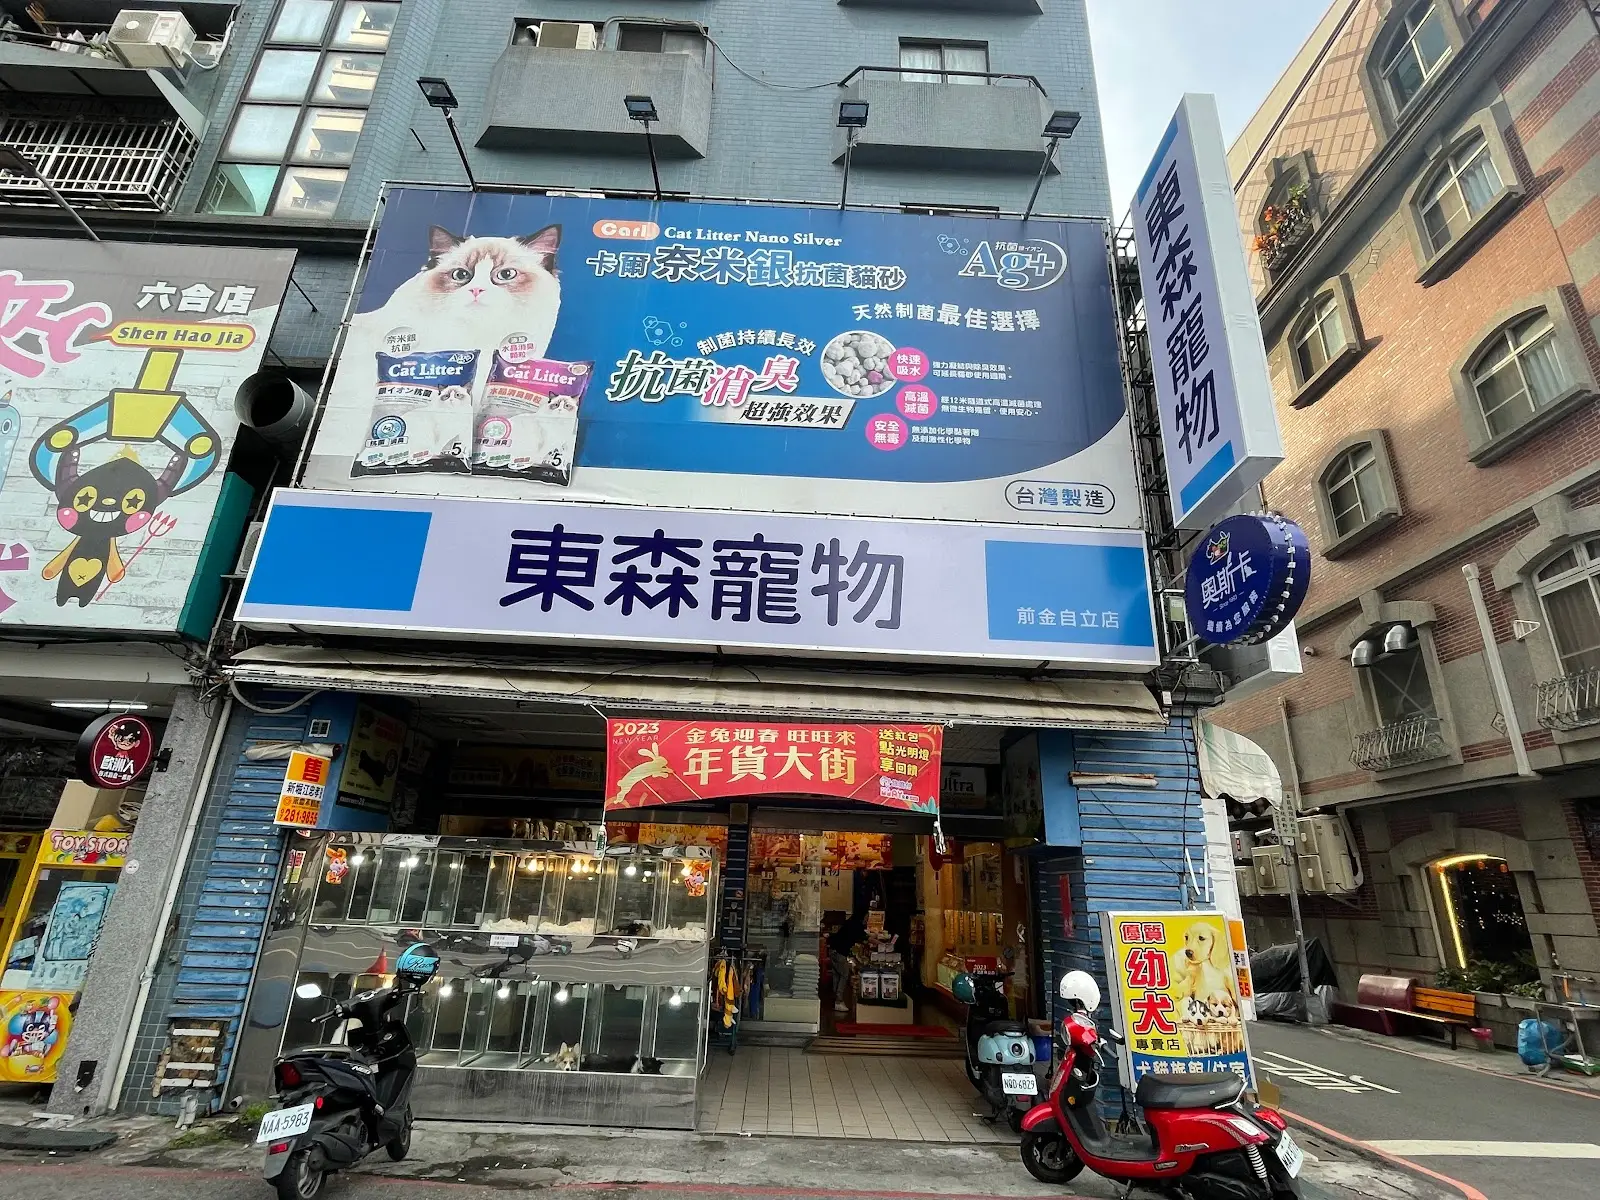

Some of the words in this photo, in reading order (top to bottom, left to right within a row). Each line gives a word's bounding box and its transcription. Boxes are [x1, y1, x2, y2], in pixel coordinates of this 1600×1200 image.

[600, 223, 647, 238] Carl
[664, 226, 692, 241] Cat
[696, 228, 741, 243] Litter
[745, 231, 789, 244] Nano
[793, 232, 842, 248] Silver
[586, 245, 907, 290] 卡爾奈米銀抗菌貓砂
[958, 241, 1055, 289] Ag+
[137, 281, 257, 314] 六合店
[852, 303, 1041, 332] 天然制菌最佳選擇
[1144, 160, 1221, 464] 東森寵物
[118, 326, 167, 342] Shen
[174, 328, 212, 343] Hao
[215, 331, 245, 346] Jia
[697, 329, 817, 357] 制菌持續長效
[896, 354, 921, 365] 快速
[388, 364, 416, 378] Cat
[419, 363, 464, 376] Litter
[503, 367, 530, 380] Cat
[532, 368, 577, 386] Litter
[605, 350, 801, 407] 抗菌消臭
[896, 365, 921, 376] 吸水
[742, 401, 842, 425] 超強效果
[904, 403, 929, 414] 滅菌
[874, 420, 900, 432] 安全
[874, 432, 900, 444] 無毒
[451, 443, 462, 456] 5
[551, 453, 562, 467] 5
[1015, 486, 1106, 508] 台灣製造
[498, 523, 905, 630] 東森寵物
[1201, 550, 1252, 609] 奧斯卡
[1016, 607, 1120, 630] 前金自立店
[613, 722, 660, 737] 2023
[684, 728, 779, 744] 金兔迎春
[788, 729, 856, 745] 旺旺來
[879, 729, 919, 743] 送紅包
[879, 741, 930, 761] 點光明燈
[303, 757, 322, 783] 售
[682, 746, 857, 785] 年貨大街
[880, 757, 918, 776] 享回饋
[53, 836, 85, 852] TOY
[88, 837, 132, 854] STOR
[1122, 923, 1164, 942] 優質
[1127, 950, 1176, 1032] 幼犬
[1136, 1039, 1180, 1051] 專賣店
[261, 1111, 310, 1136] NAA-5983
